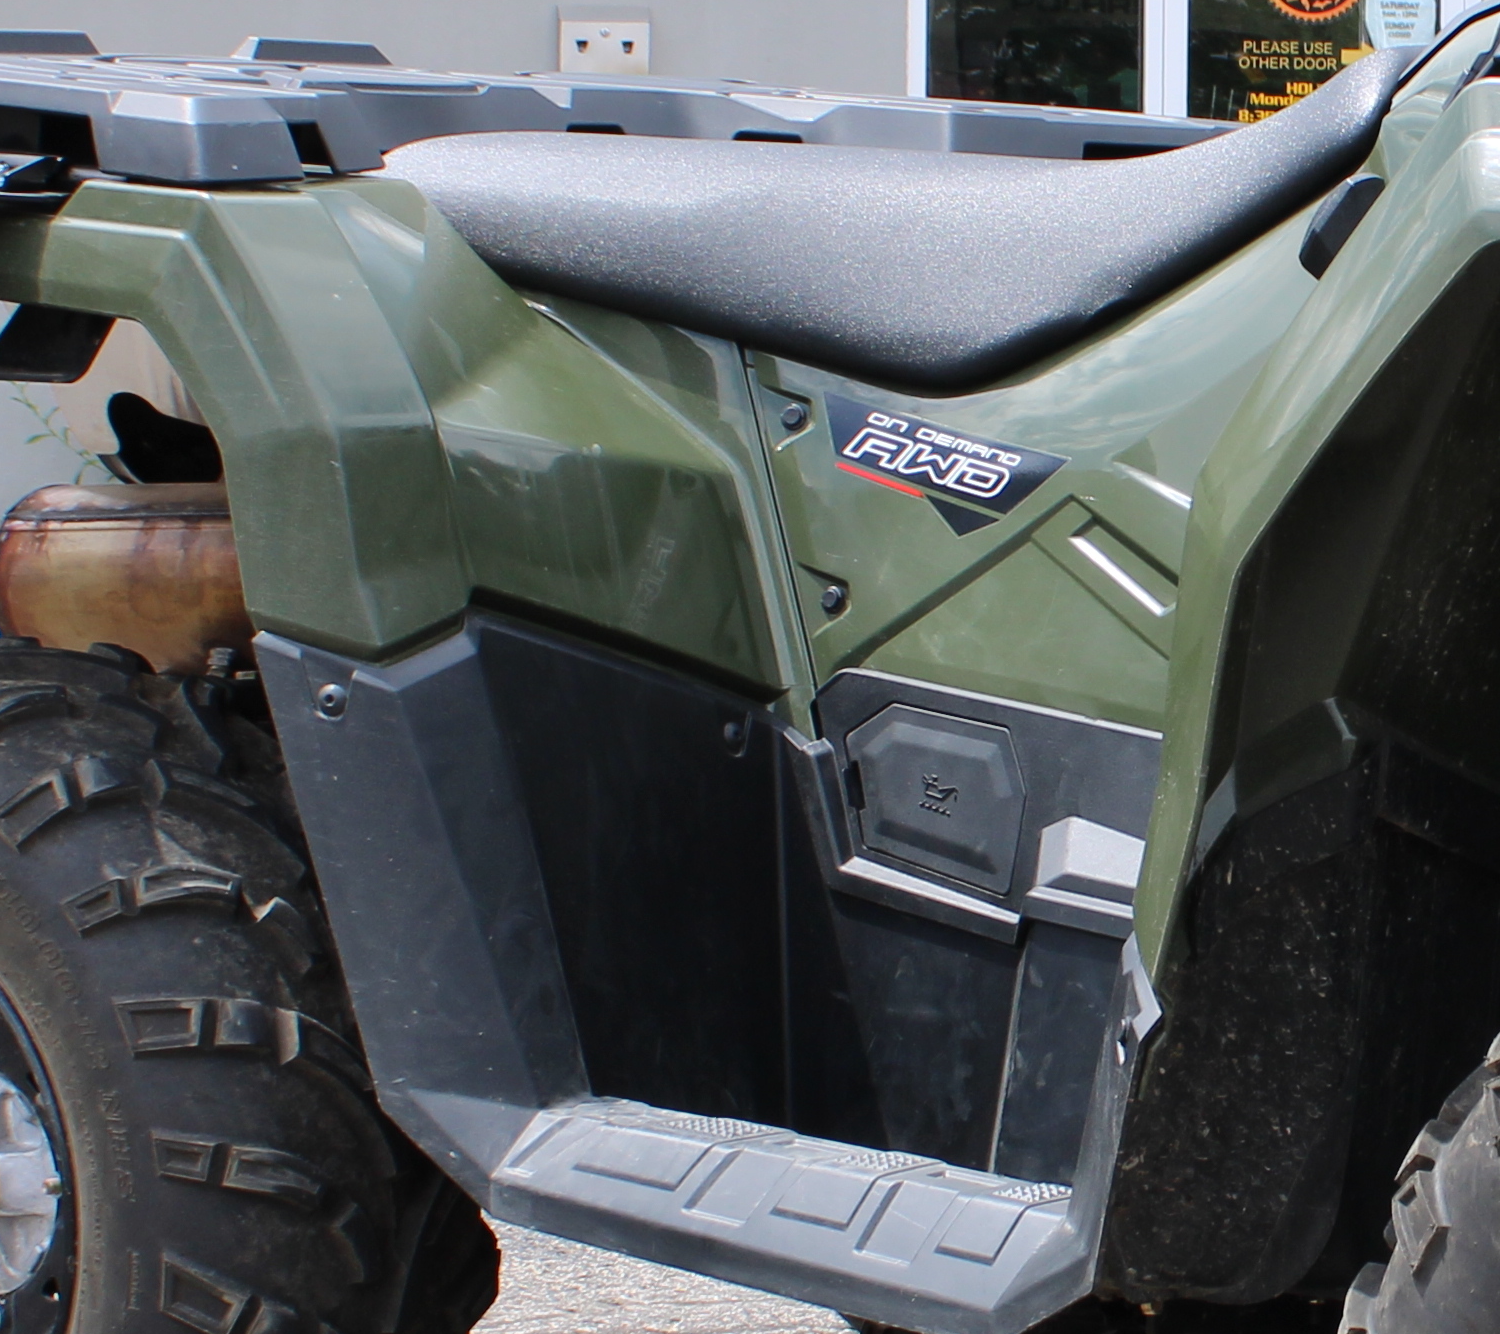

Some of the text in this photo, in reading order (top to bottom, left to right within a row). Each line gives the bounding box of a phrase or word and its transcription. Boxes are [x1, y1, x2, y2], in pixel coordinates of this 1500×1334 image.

[1238, 55, 1338, 72] OTHER DOOR
[1242, 39, 1333, 55] PLEASE USE
[865, 410, 1023, 468] ON DEMAND
[841, 426, 1012, 500] AWD
